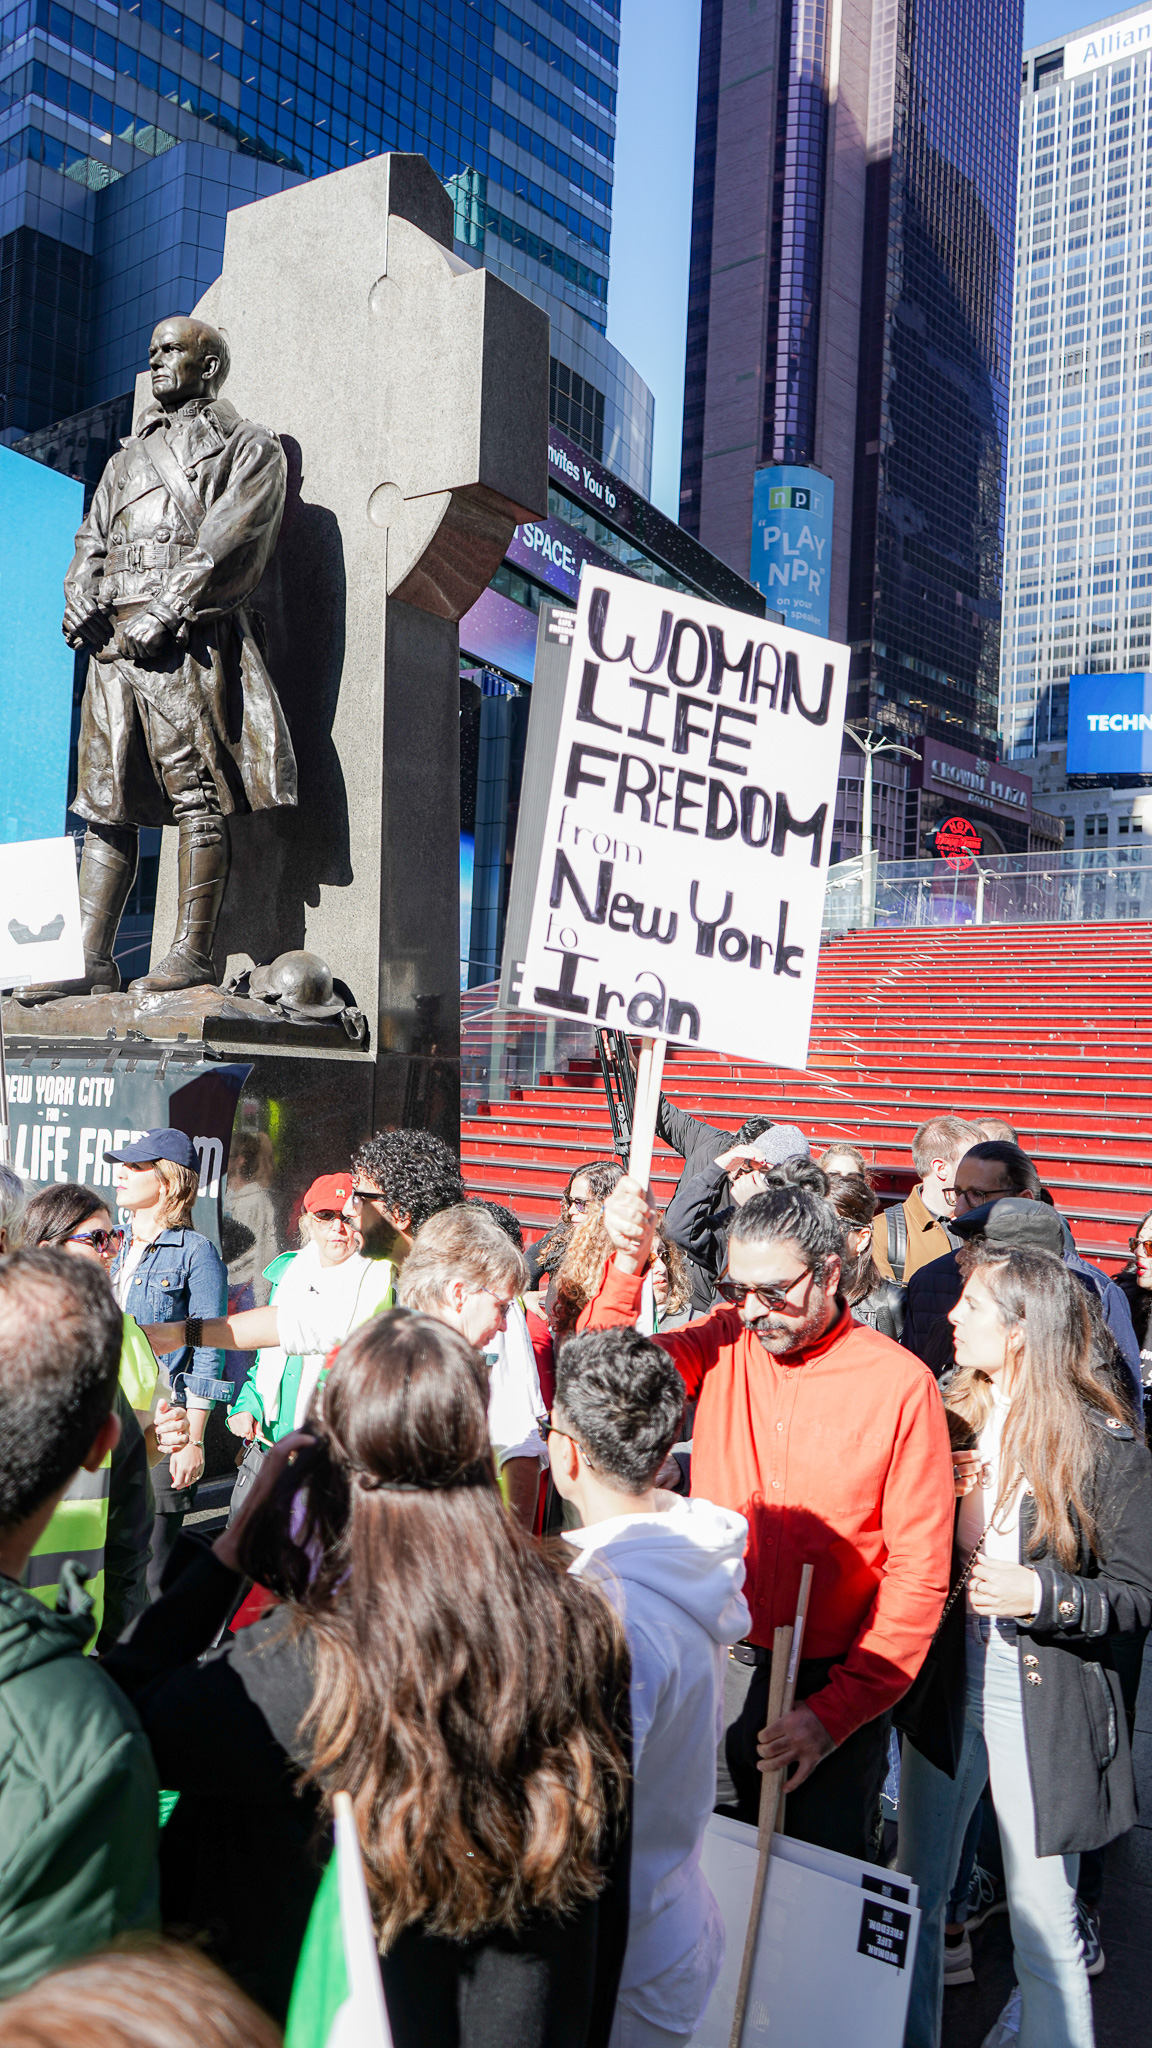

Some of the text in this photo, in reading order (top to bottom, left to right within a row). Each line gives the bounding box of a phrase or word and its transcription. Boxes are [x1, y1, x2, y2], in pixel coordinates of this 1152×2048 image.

[582, 466, 603, 499] You
[604, 485, 616, 509] to
[774, 489, 820, 509] npr
[522, 522, 576, 576] SPACE:
[776, 597, 813, 609] on your
[588, 586, 835, 726] WOMAN
[576, 659, 758, 776] LIFE
[1087, 713, 1152, 732] TECHN
[564, 741, 829, 868] FREEDOM
[557, 804, 642, 865] from
[546, 912, 578, 949] to
[549, 848, 804, 978] New York
[534, 946, 701, 1041] Iran
[36, 1075, 76, 1106] YORK
[78, 1076, 115, 1107] CITY
[46, 1107, 60, 1122] FOR
[15, 1124, 71, 1183] LIFE
